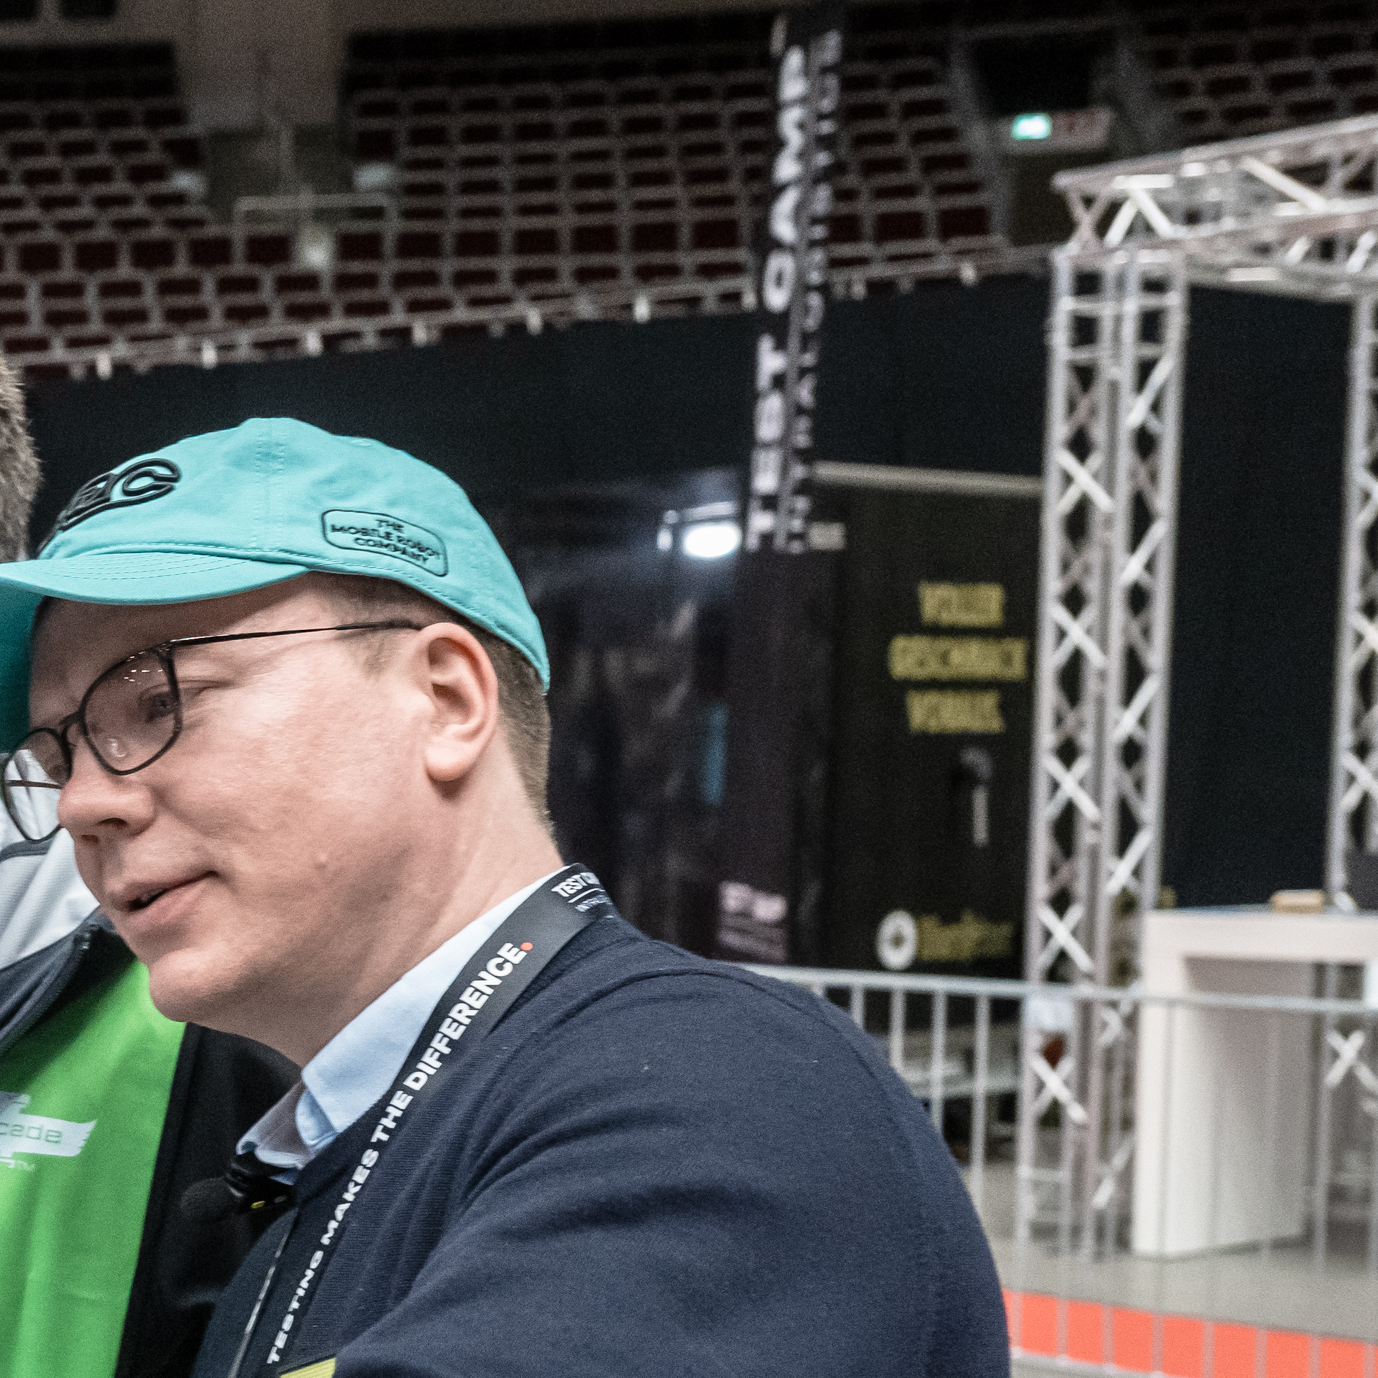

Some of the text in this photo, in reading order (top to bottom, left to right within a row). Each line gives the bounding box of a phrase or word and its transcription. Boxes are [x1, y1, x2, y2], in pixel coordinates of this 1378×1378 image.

[746, 44, 809, 553] TEST CAMP
[376, 519, 404, 532] THE
[267, 942, 533, 1364] TESTING MAKES THE DIFFERENCE.
